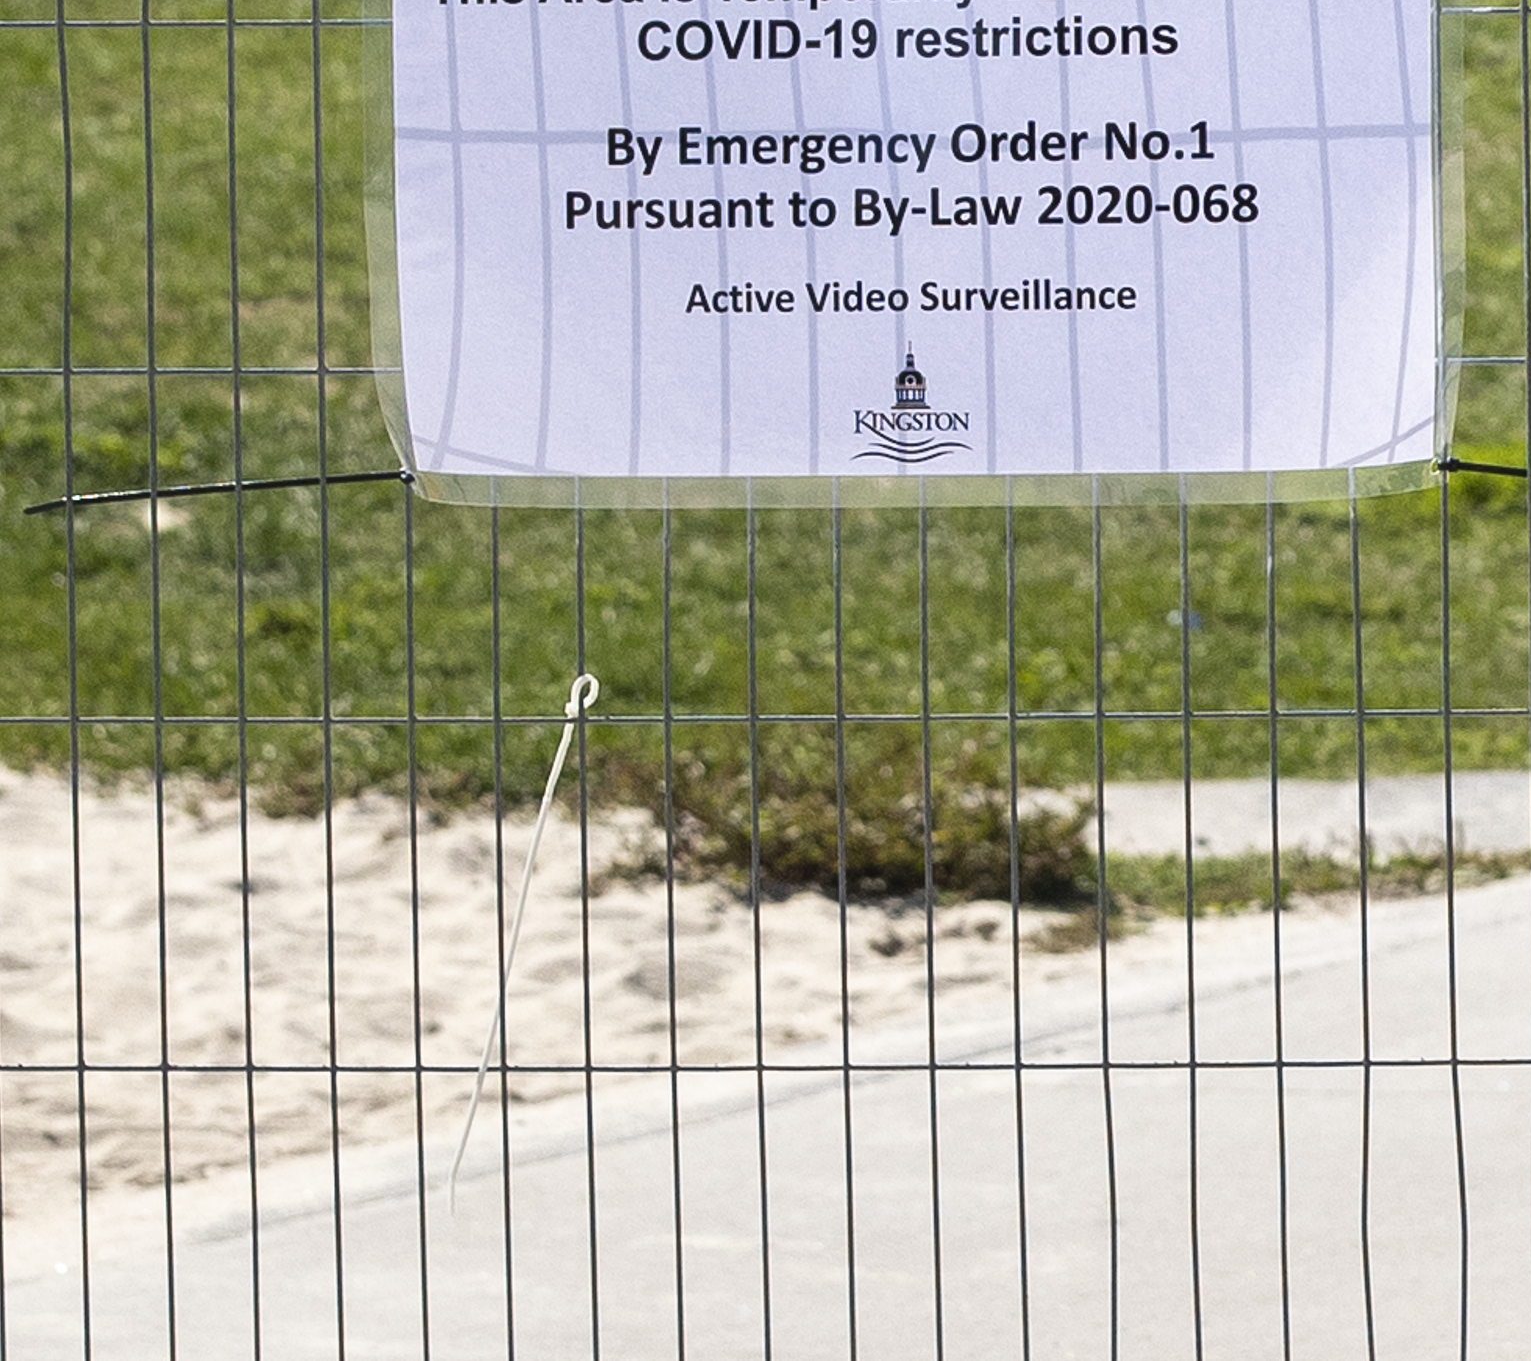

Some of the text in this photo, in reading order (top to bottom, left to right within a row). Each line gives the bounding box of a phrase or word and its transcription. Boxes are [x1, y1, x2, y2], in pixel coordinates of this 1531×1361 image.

[638, 15, 1178, 61] COVID-19 restrictions
[607, 120, 1214, 176] By Emergency Order No.1
[566, 183, 1259, 237] Pursuant to By-Law 2020-068
[685, 278, 1137, 314] Active Video Surveillance
[853, 409, 970, 435] KINGSTON
